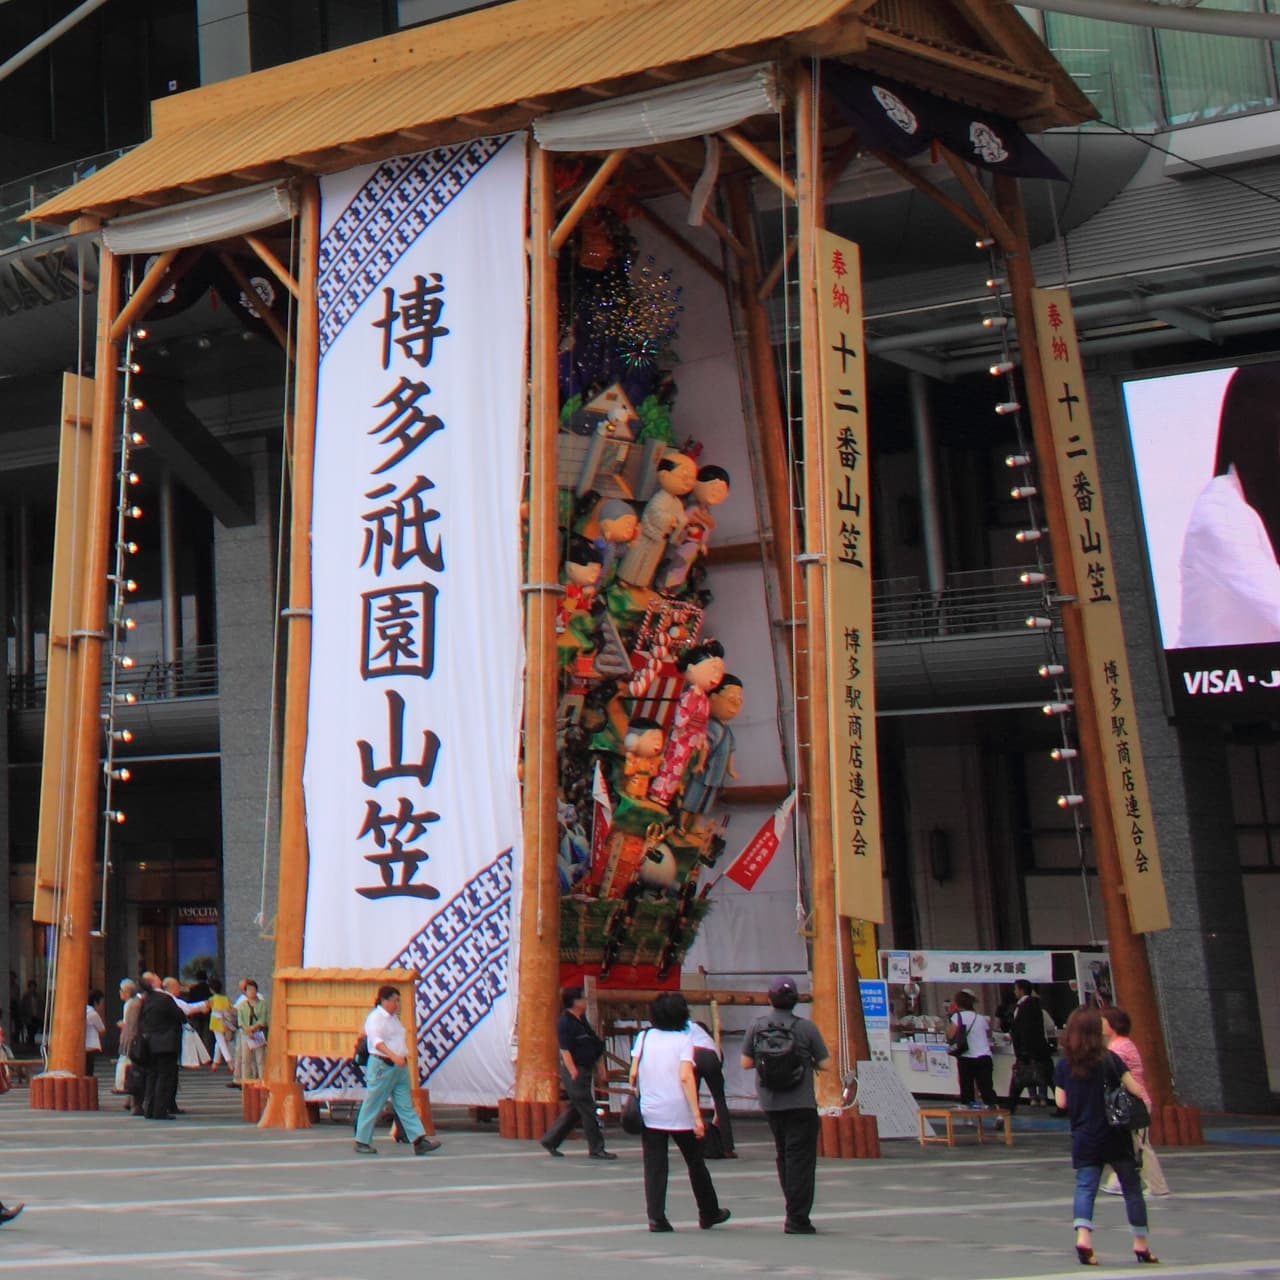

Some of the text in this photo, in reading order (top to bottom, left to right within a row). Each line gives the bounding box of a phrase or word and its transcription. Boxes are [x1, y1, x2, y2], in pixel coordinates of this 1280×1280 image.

[355, 272, 450, 901] 博多祇園山笠
[831, 248, 868, 857] 奉納 十二番山笠 博多駅商店連合会
[1048, 303, 1148, 873] 奉納 十二番山笠 博多駅商店連合会
[1183, 669, 1243, 695] VISA
